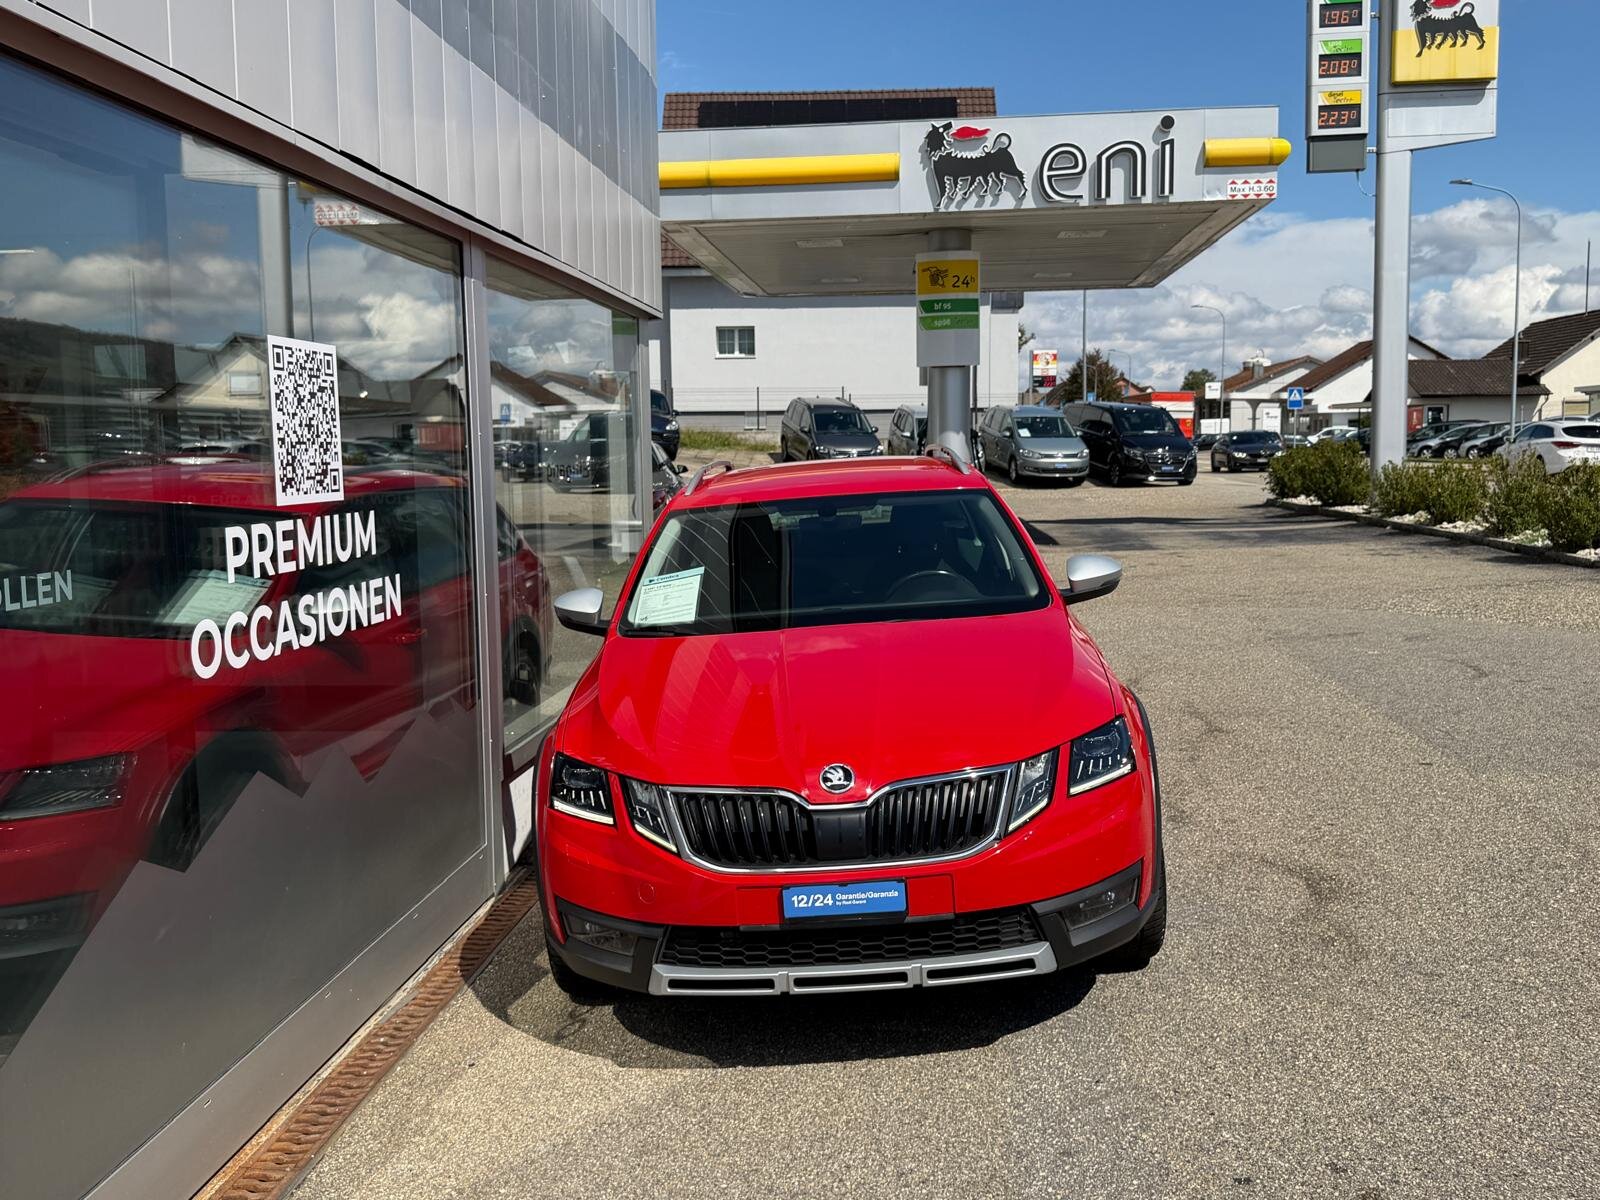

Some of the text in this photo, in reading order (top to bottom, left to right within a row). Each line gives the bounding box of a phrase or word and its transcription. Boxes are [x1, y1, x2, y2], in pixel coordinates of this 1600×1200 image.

[1039, 115, 1175, 203] eni
[224, 510, 377, 584] PREMIUM
[0, 569, 73, 612] LLEN
[190, 573, 402, 679] OCCASIONEN
[791, 889, 899, 908] 12/24 Garantie/Garanzia
